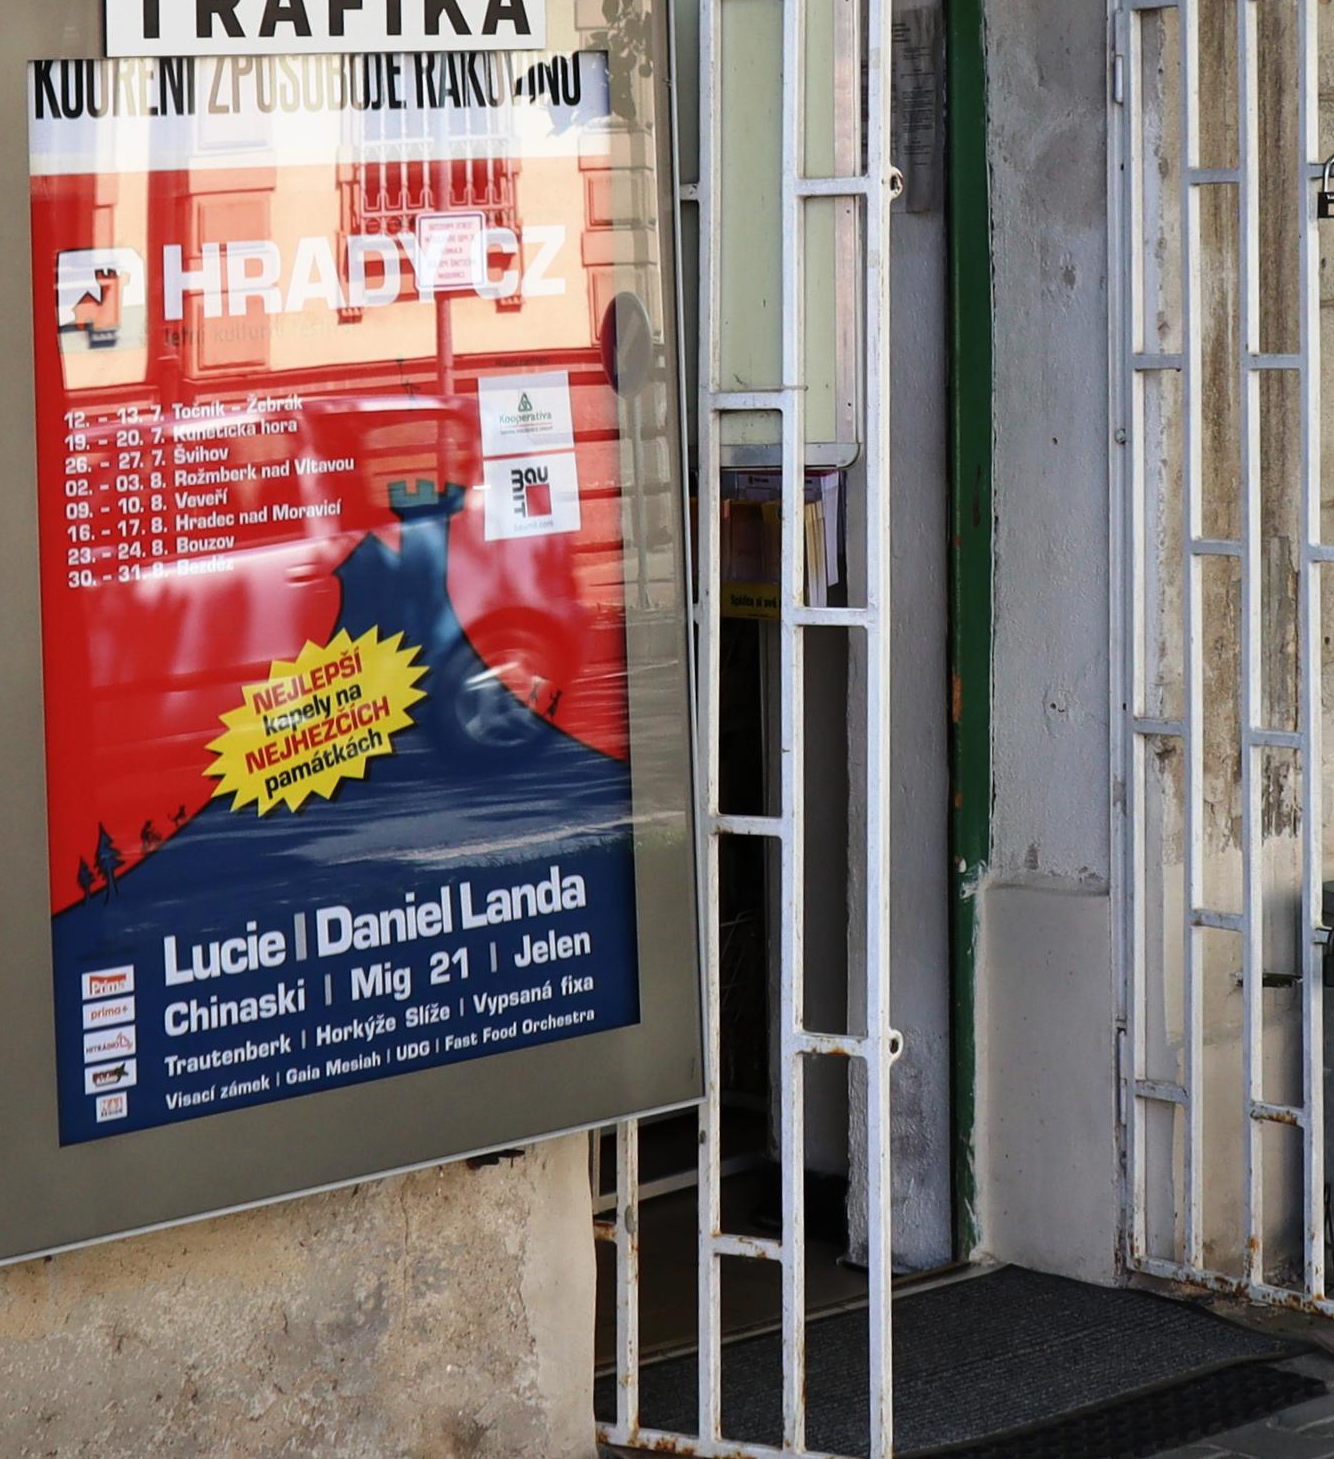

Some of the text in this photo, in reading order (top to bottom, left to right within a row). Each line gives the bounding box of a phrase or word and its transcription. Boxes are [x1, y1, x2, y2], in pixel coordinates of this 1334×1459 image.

[64, 393, 303, 429] 12. 13. 7. Točník Žebrák
[65, 434, 89, 452] 19.
[117, 429, 144, 448] 20.
[151, 427, 165, 445] 7.
[261, 418, 298, 435] hora
[65, 443, 228, 475] 26. 27. 7. Švihov
[65, 457, 355, 497] 02. 03. 8. Rožmberk nad Vltavou
[66, 488, 228, 520] 09. 10. 8. Veveří
[67, 498, 342, 543] 16. 17. 8. Hradec nad Moravicí
[68, 535, 235, 566] 23. 24. 8. Bouzov
[68, 569, 97, 589] 30.
[118, 564, 147, 583] 31.
[152, 562, 169, 579] 8.
[252, 646, 363, 716] NEJLEPŠÍ
[244, 695, 391, 774] NEJHEZČÍCH
[262, 683, 362, 737] kapely na
[264, 728, 383, 799] památkách
[163, 865, 587, 987] Lucie Daniel Landa
[164, 929, 591, 1037] Chinaski Mig 21 Jelen
[164, 974, 595, 1078] Trautenberk Horkýže Slíže Vypsaná fixa
[165, 1008, 595, 1111] Visací zámek Gaia Mesiah UDG Fast Food Orchestra
